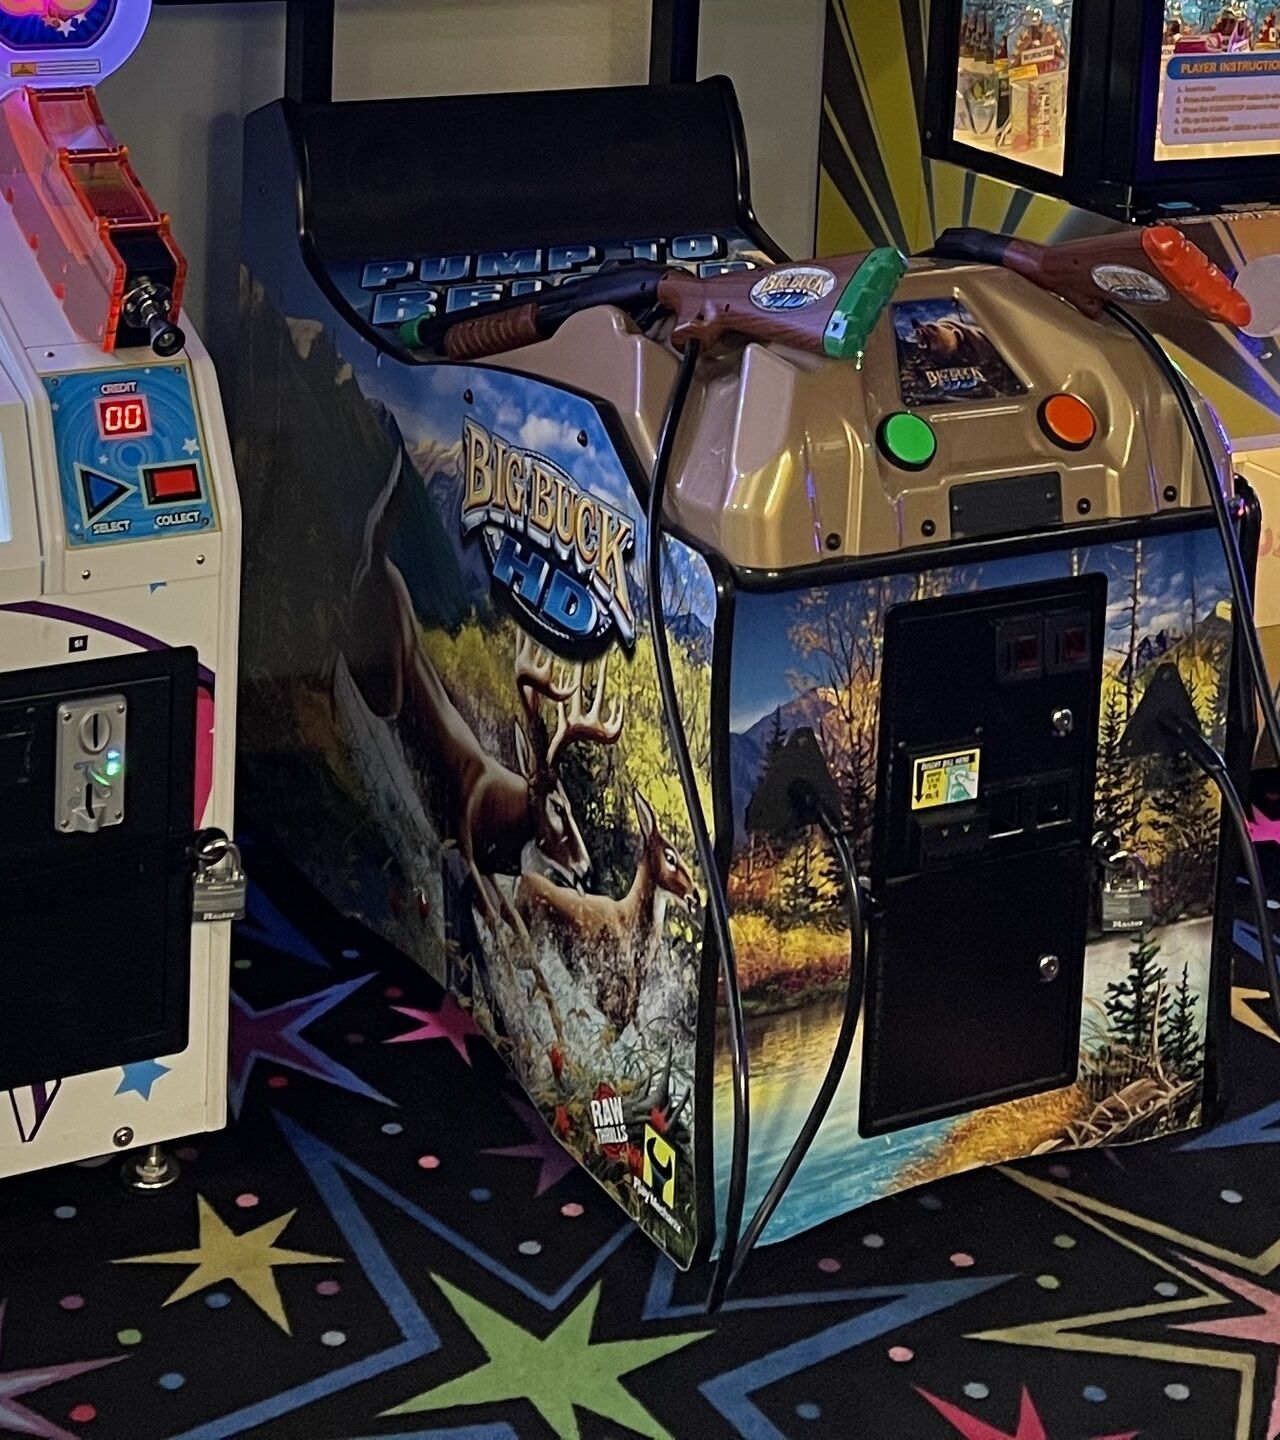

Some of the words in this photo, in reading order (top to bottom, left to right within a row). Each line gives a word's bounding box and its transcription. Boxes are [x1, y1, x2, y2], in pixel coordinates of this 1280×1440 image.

[1180, 61, 1217, 74] PLAYER
[360, 244, 598, 289] PUMP
[623, 233, 720, 261] TO
[760, 273, 791, 293] BIG
[790, 273, 826, 298] BUCK
[100, 382, 137, 395] CREDIT
[105, 404, 143, 431] 00
[91, 520, 131, 535] SELECT
[155, 511, 201, 527] COLLECT
[462, 417, 526, 528] BIG
[529, 460, 637, 645] BUCK
[492, 535, 598, 638] HD
[590, 1096, 625, 1127] RAW
[594, 1124, 629, 1145] THRILLS
